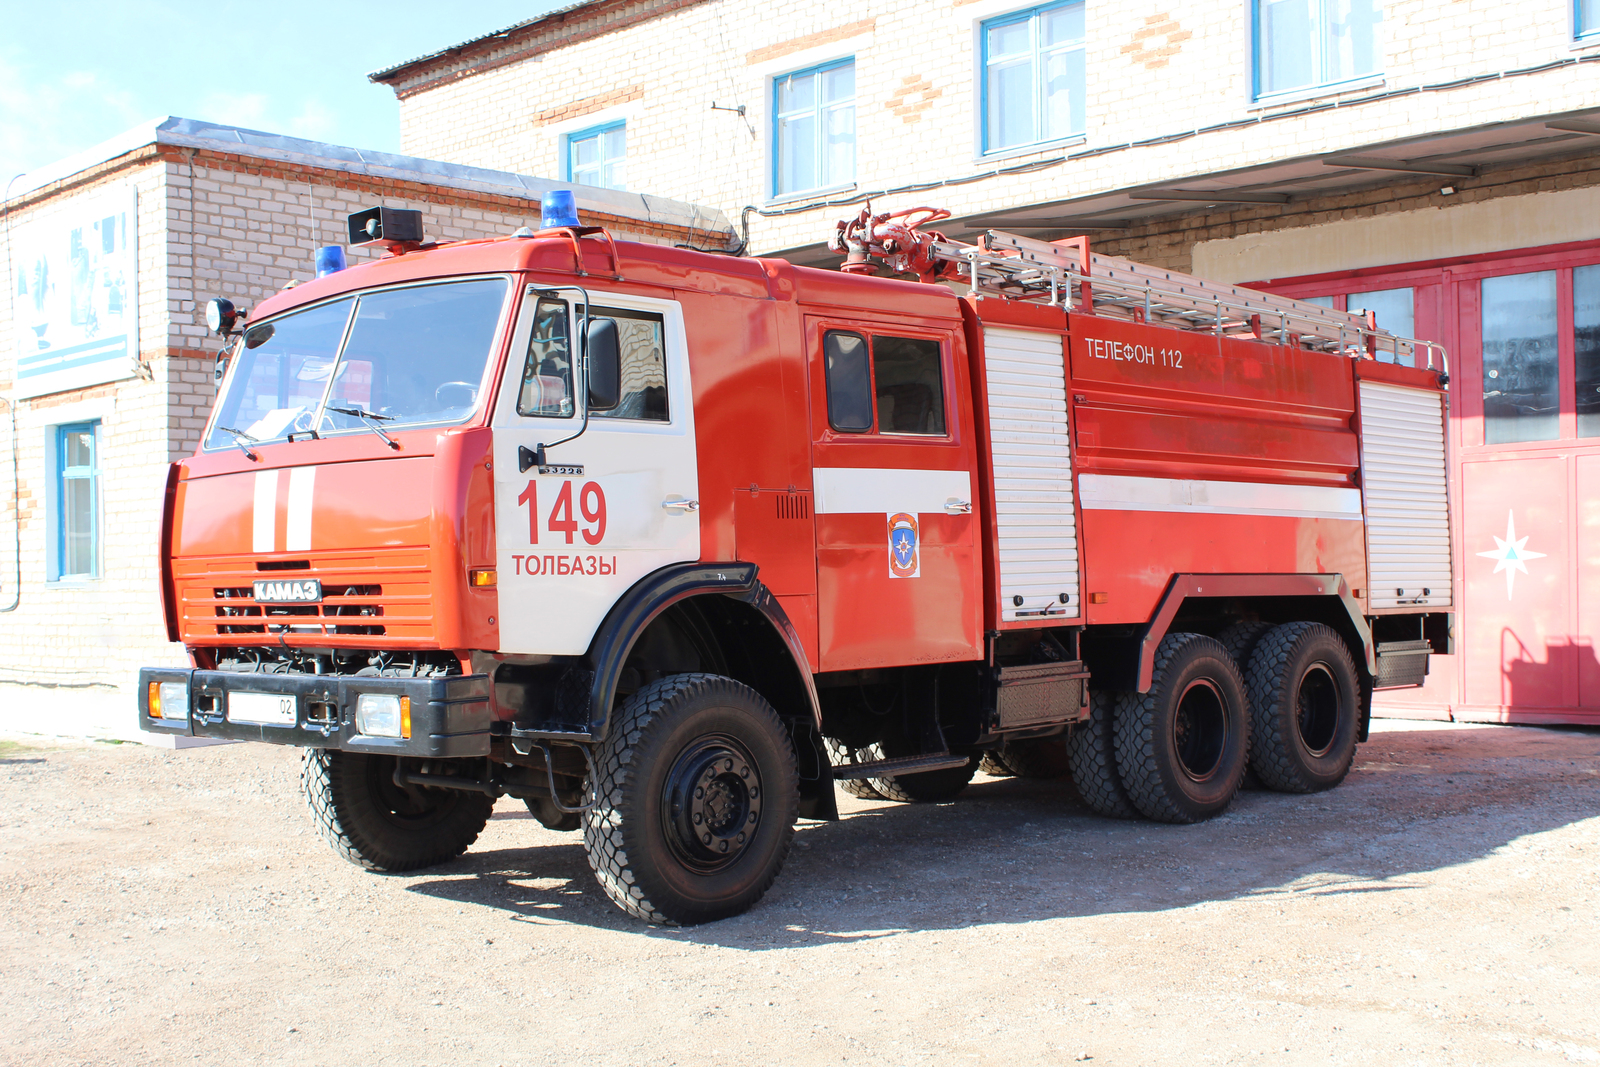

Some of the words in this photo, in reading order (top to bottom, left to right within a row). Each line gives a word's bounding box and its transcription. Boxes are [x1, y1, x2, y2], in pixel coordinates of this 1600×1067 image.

[1084, 337, 1154, 365] ТЕЛЕФОН
[1160, 348, 1183, 369] 112
[518, 479, 607, 545] 149
[512, 555, 616, 575] ТОЛБАЗЫ
[254, 581, 318, 600] КАМАЗ
[280, 699, 292, 714] 02
